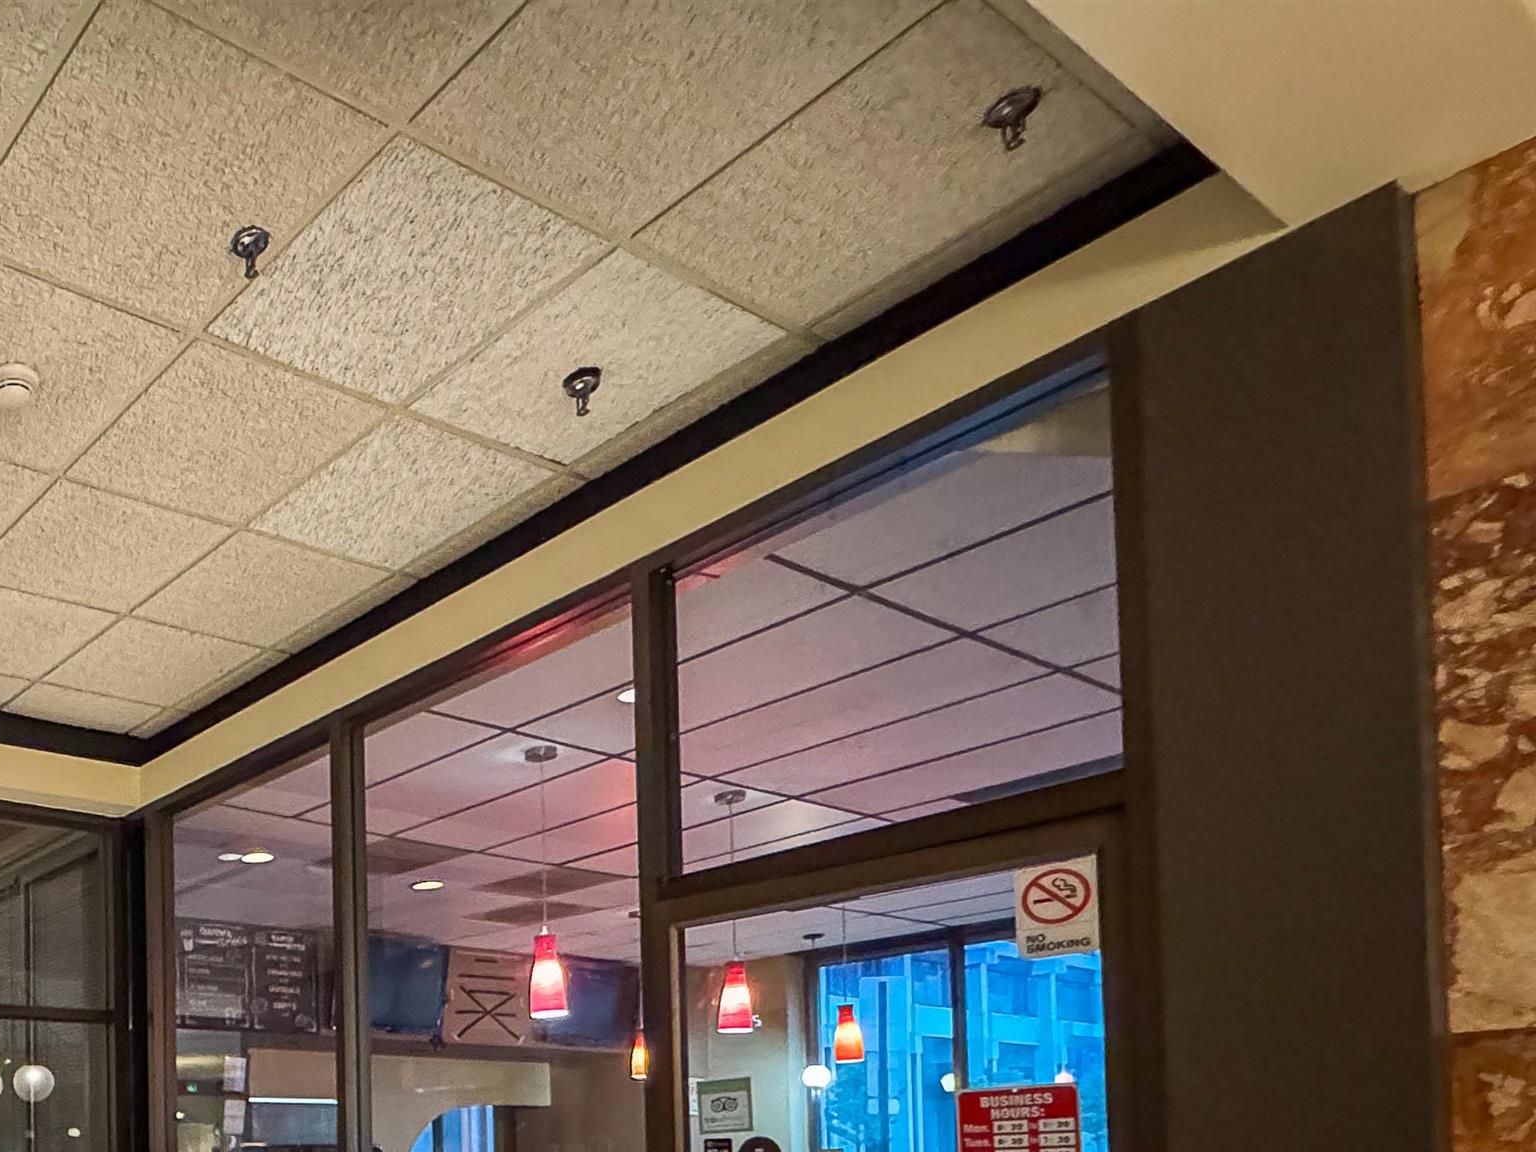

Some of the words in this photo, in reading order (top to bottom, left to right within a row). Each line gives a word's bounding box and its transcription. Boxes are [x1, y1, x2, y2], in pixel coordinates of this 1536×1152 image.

[1026, 934, 1046, 943] NO
[1026, 937, 1091, 954] SMOKING
[979, 1093, 1054, 1108] BUSINESS
[990, 1106, 1046, 1120] HOURS:
